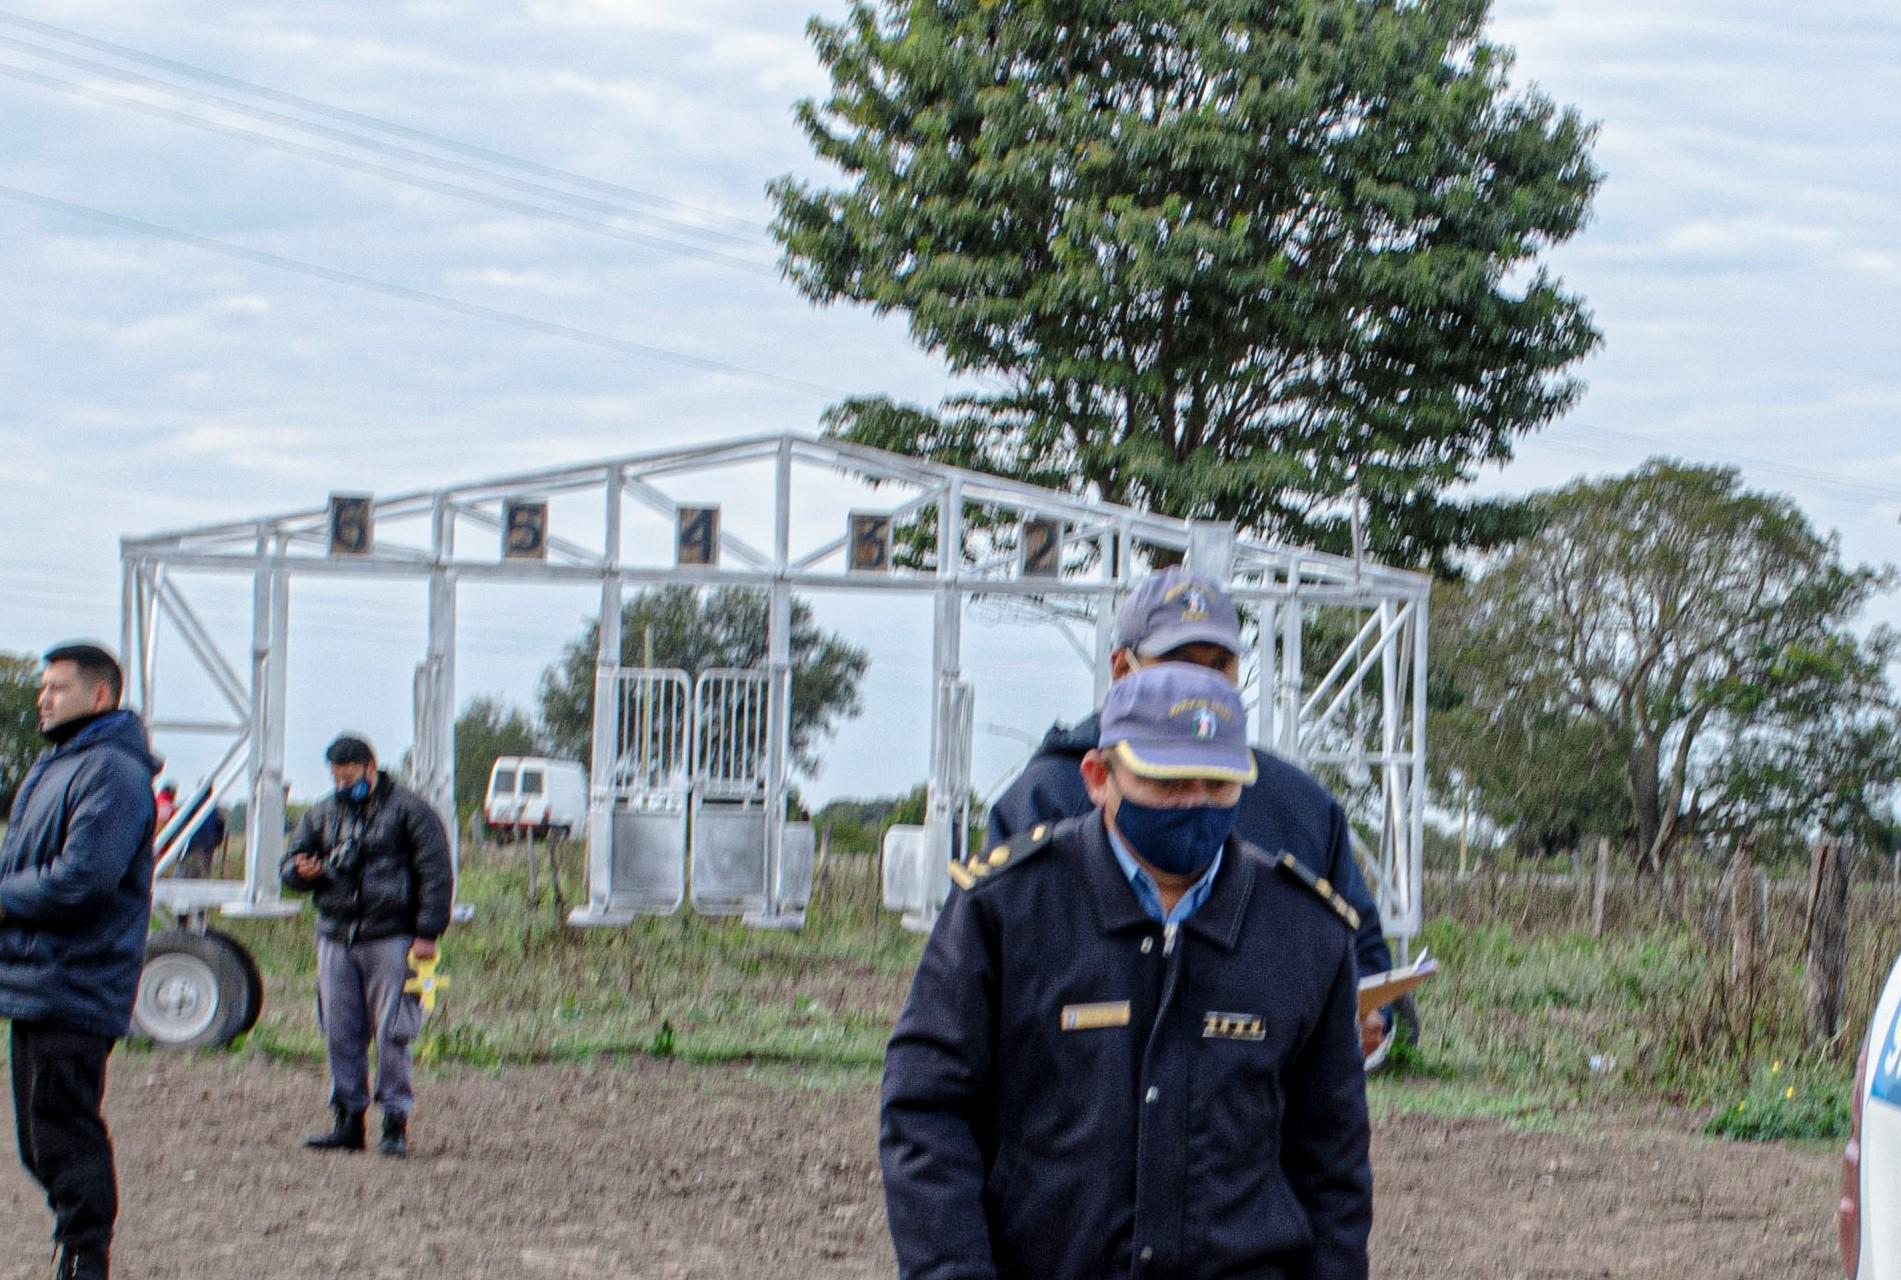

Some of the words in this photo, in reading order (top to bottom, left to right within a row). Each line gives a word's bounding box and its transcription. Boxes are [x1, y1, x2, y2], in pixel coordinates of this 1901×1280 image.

[507, 503, 542, 553] 5
[678, 508, 713, 563] 4
[856, 516, 889, 570] 3
